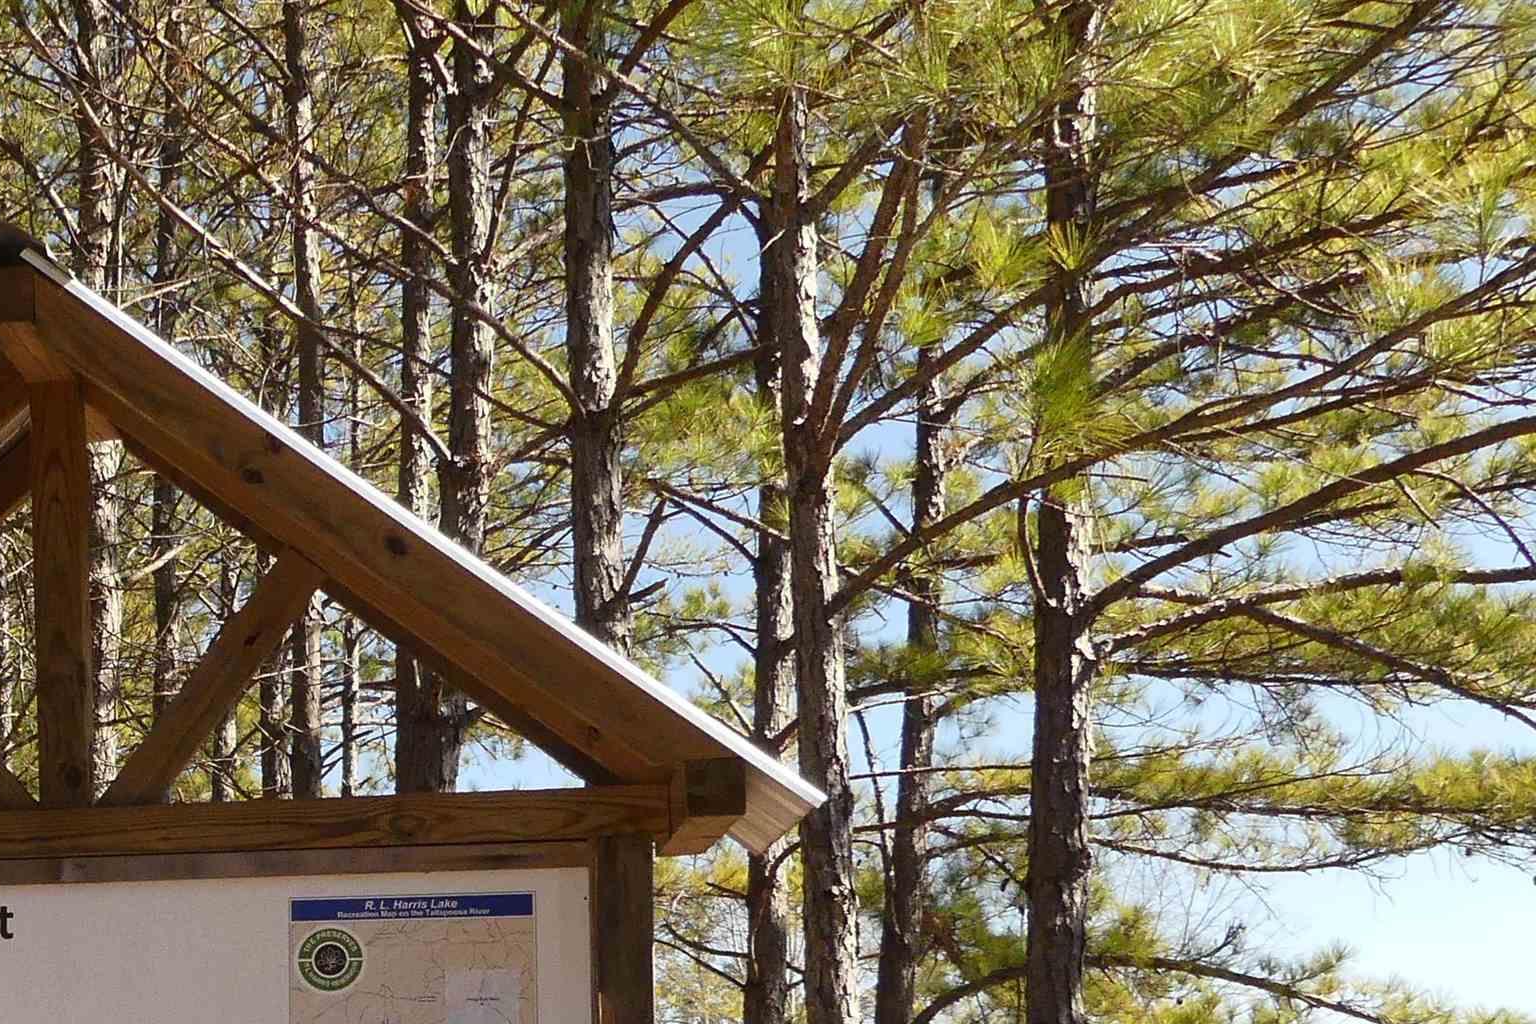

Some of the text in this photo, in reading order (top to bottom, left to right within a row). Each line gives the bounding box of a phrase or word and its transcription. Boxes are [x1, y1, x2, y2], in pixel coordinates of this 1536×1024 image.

[364, 898, 458, 910] R. L. Harris Lake
